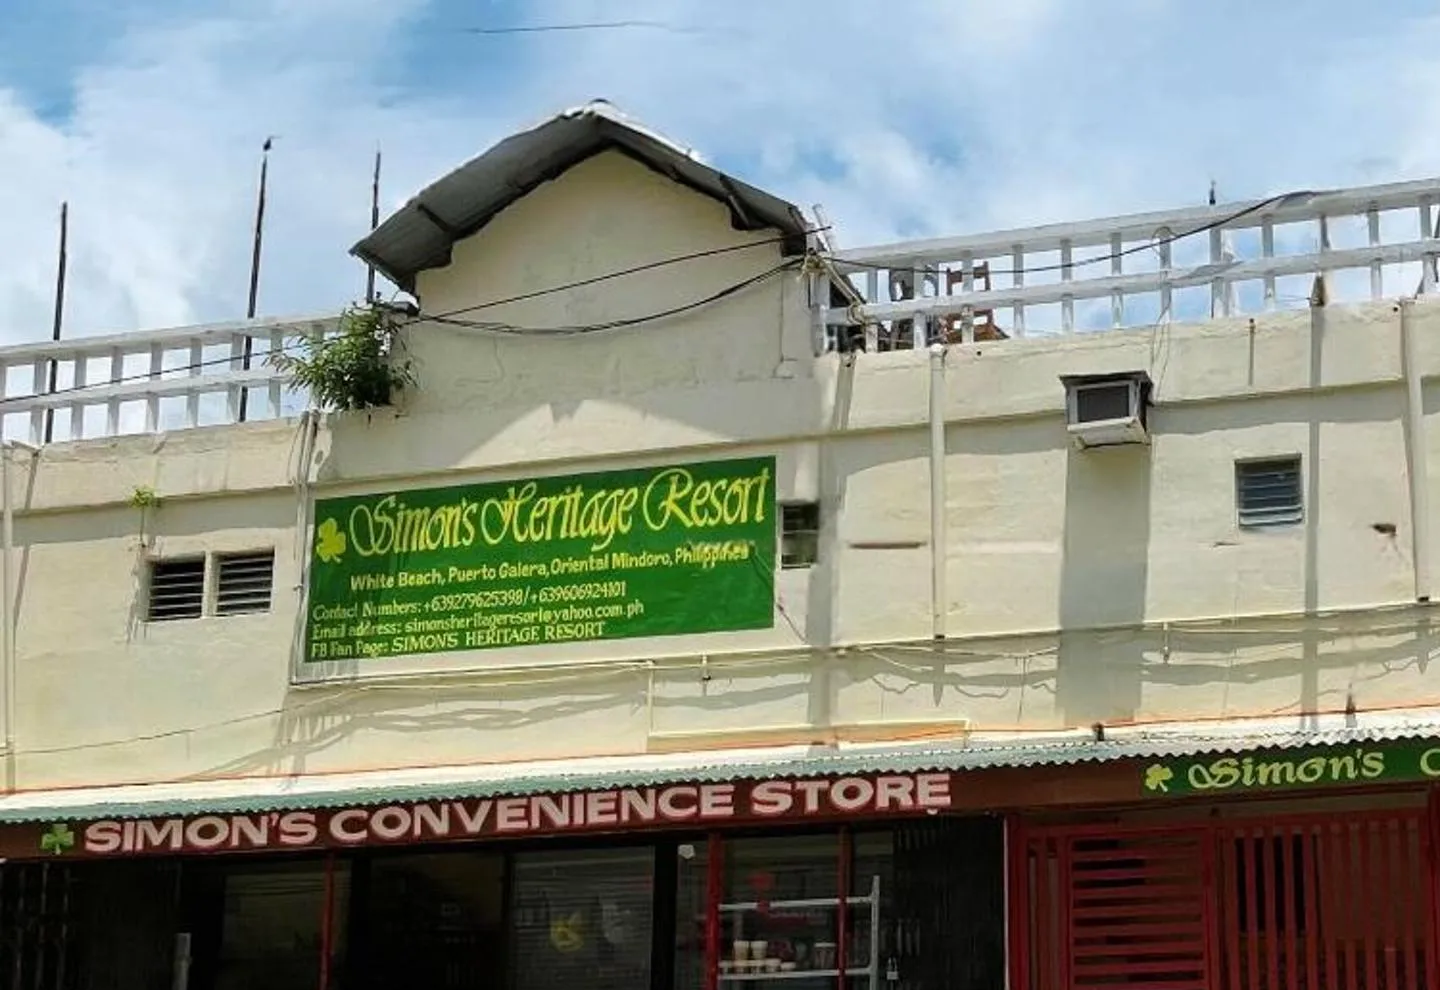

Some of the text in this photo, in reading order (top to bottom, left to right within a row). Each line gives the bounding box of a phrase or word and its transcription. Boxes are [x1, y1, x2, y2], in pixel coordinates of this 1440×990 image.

[350, 467, 771, 557] Simon's Heritage Resort
[351, 573, 394, 591] White
[399, 569, 446, 587] Beach,
[448, 564, 496, 583] Puerto
[499, 561, 550, 580] Galera,
[551, 553, 609, 575] Oriental
[612, 549, 673, 570] Mindoro,
[312, 604, 357, 621] Contact
[312, 624, 345, 641] Email
[311, 643, 326, 658] FB
[330, 641, 352, 657] Fan
[356, 640, 388, 659] Page:
[465, 625, 540, 647] HERITAGE
[545, 621, 606, 641] RESORT
[1188, 749, 1384, 790] Simon's
[85, 772, 952, 853] SIMON'S CONVENIENCE STORE
